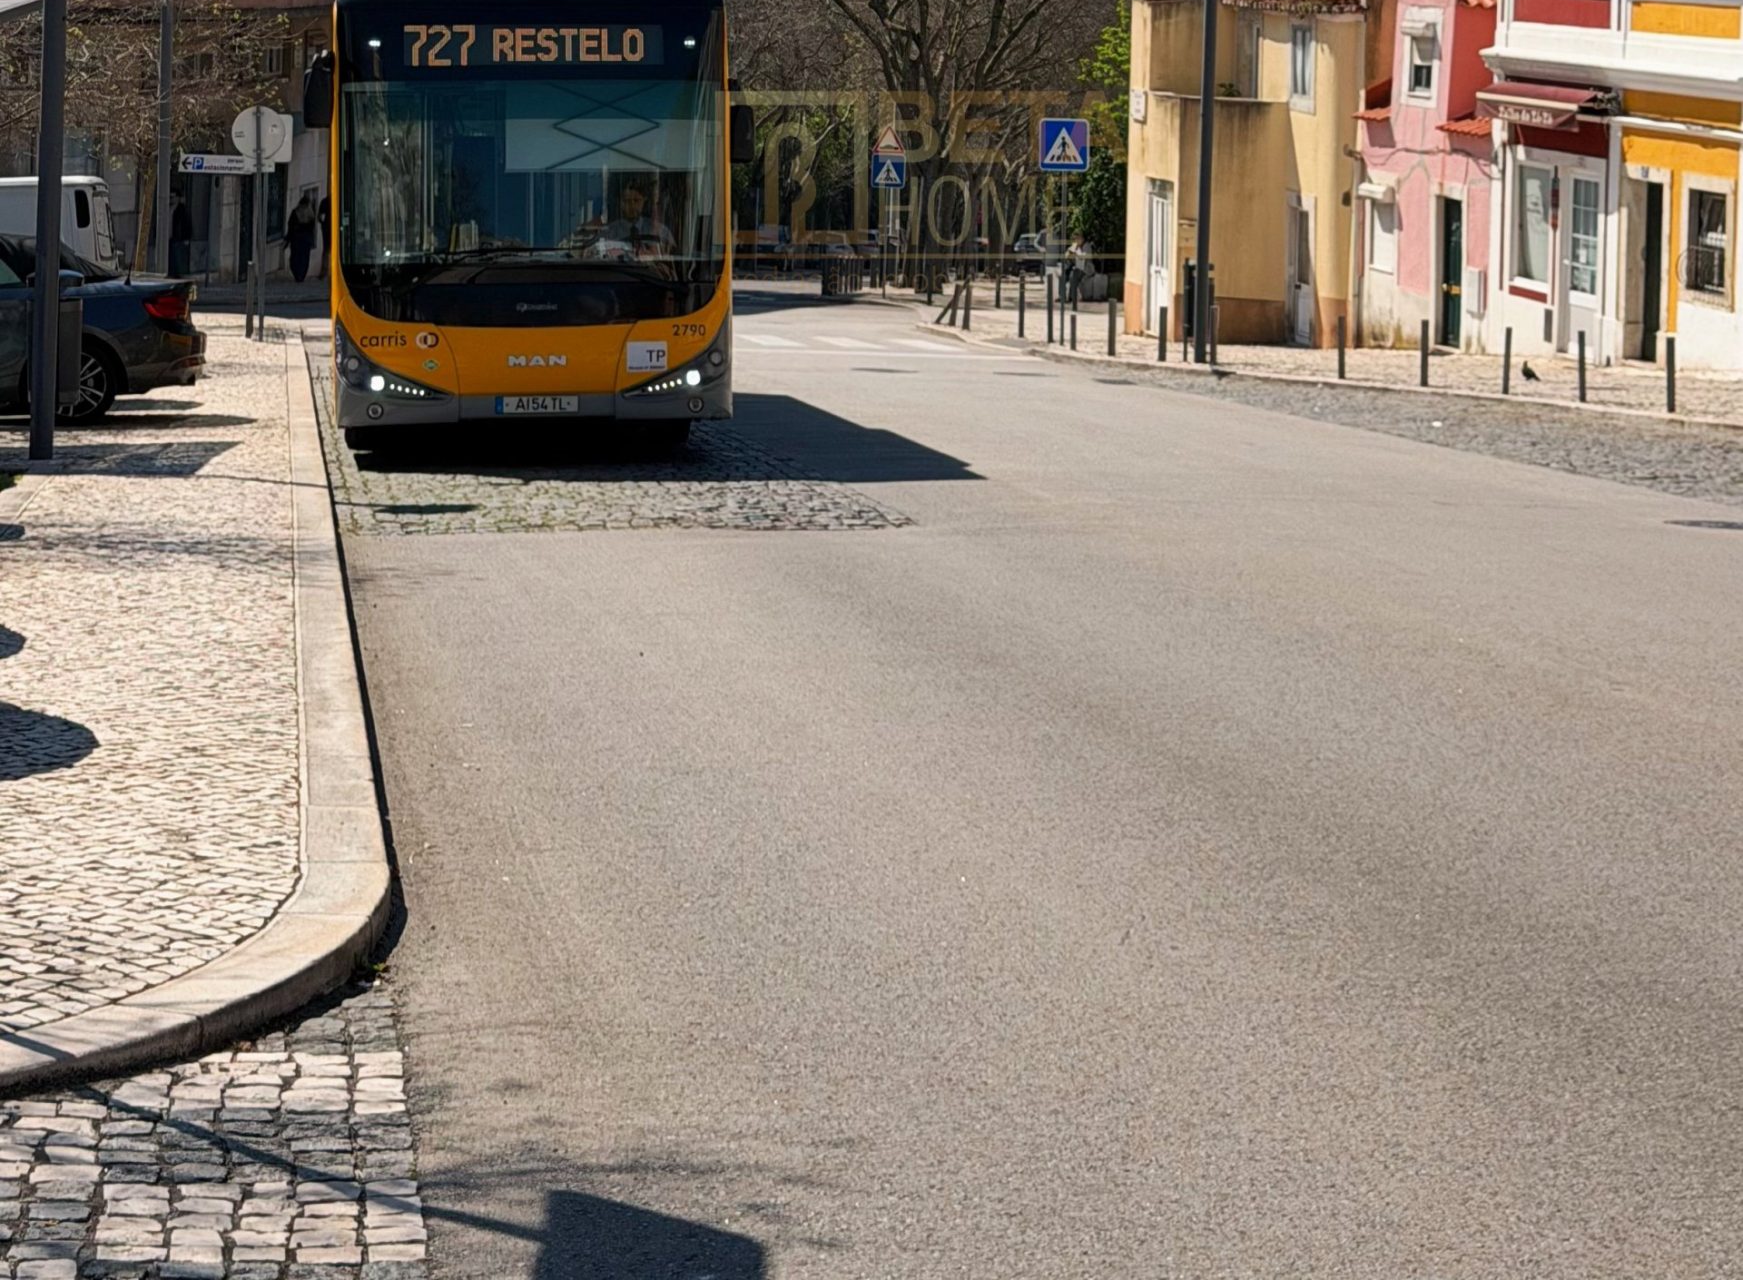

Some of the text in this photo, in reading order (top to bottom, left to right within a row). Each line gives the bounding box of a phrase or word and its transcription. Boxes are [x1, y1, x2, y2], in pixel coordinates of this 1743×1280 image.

[404, 24, 644, 67] 727 RESTELO
[672, 324, 706, 337] 2790
[360, 330, 407, 348] carris
[508, 355, 567, 367] MAN
[646, 349, 666, 362] TP
